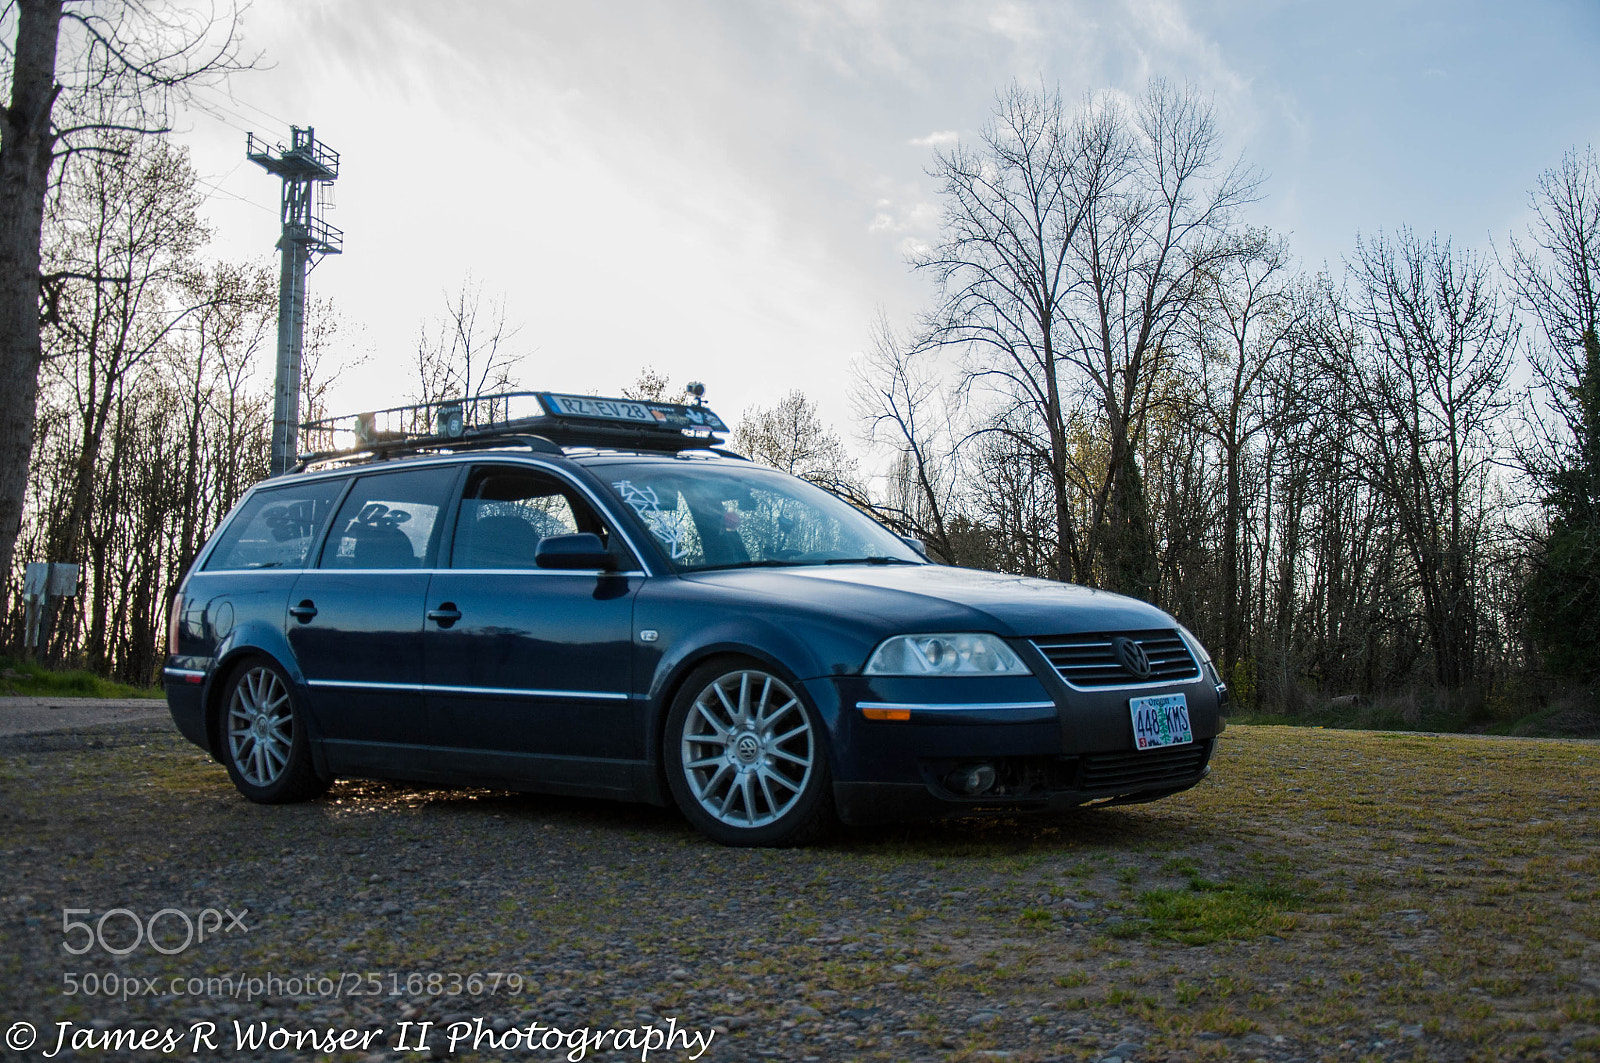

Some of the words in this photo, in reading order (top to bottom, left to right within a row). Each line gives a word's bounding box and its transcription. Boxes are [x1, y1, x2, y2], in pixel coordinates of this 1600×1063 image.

[1148, 697, 1170, 707] Oregon
[1137, 708, 1160, 737] 448
[1164, 705, 1188, 734] KMS
